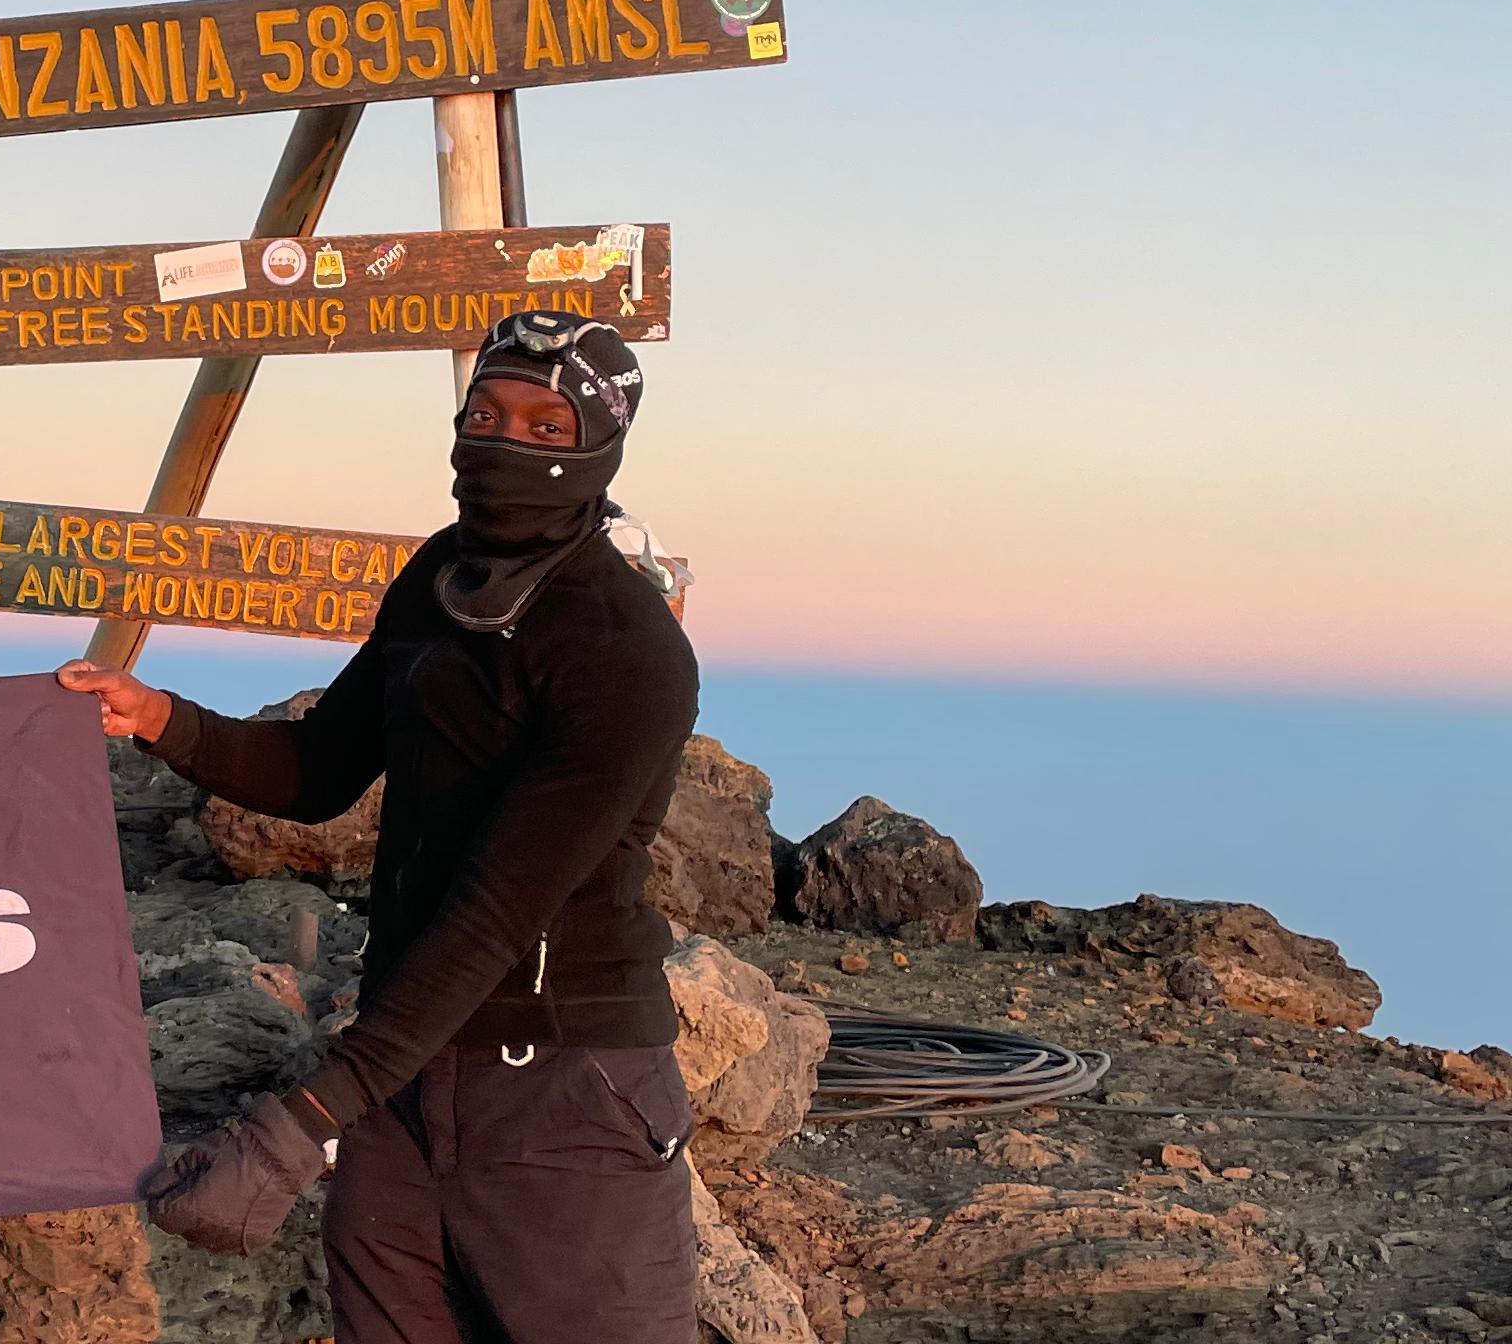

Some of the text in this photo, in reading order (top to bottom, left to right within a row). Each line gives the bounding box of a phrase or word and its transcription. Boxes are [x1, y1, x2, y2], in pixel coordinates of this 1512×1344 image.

[0, 260, 138, 303] POINT
[122, 296, 348, 344] STANDING
[17, 565, 106, 610] AND
[122, 572, 302, 629] WONDER
[314, 589, 373, 633] OF
